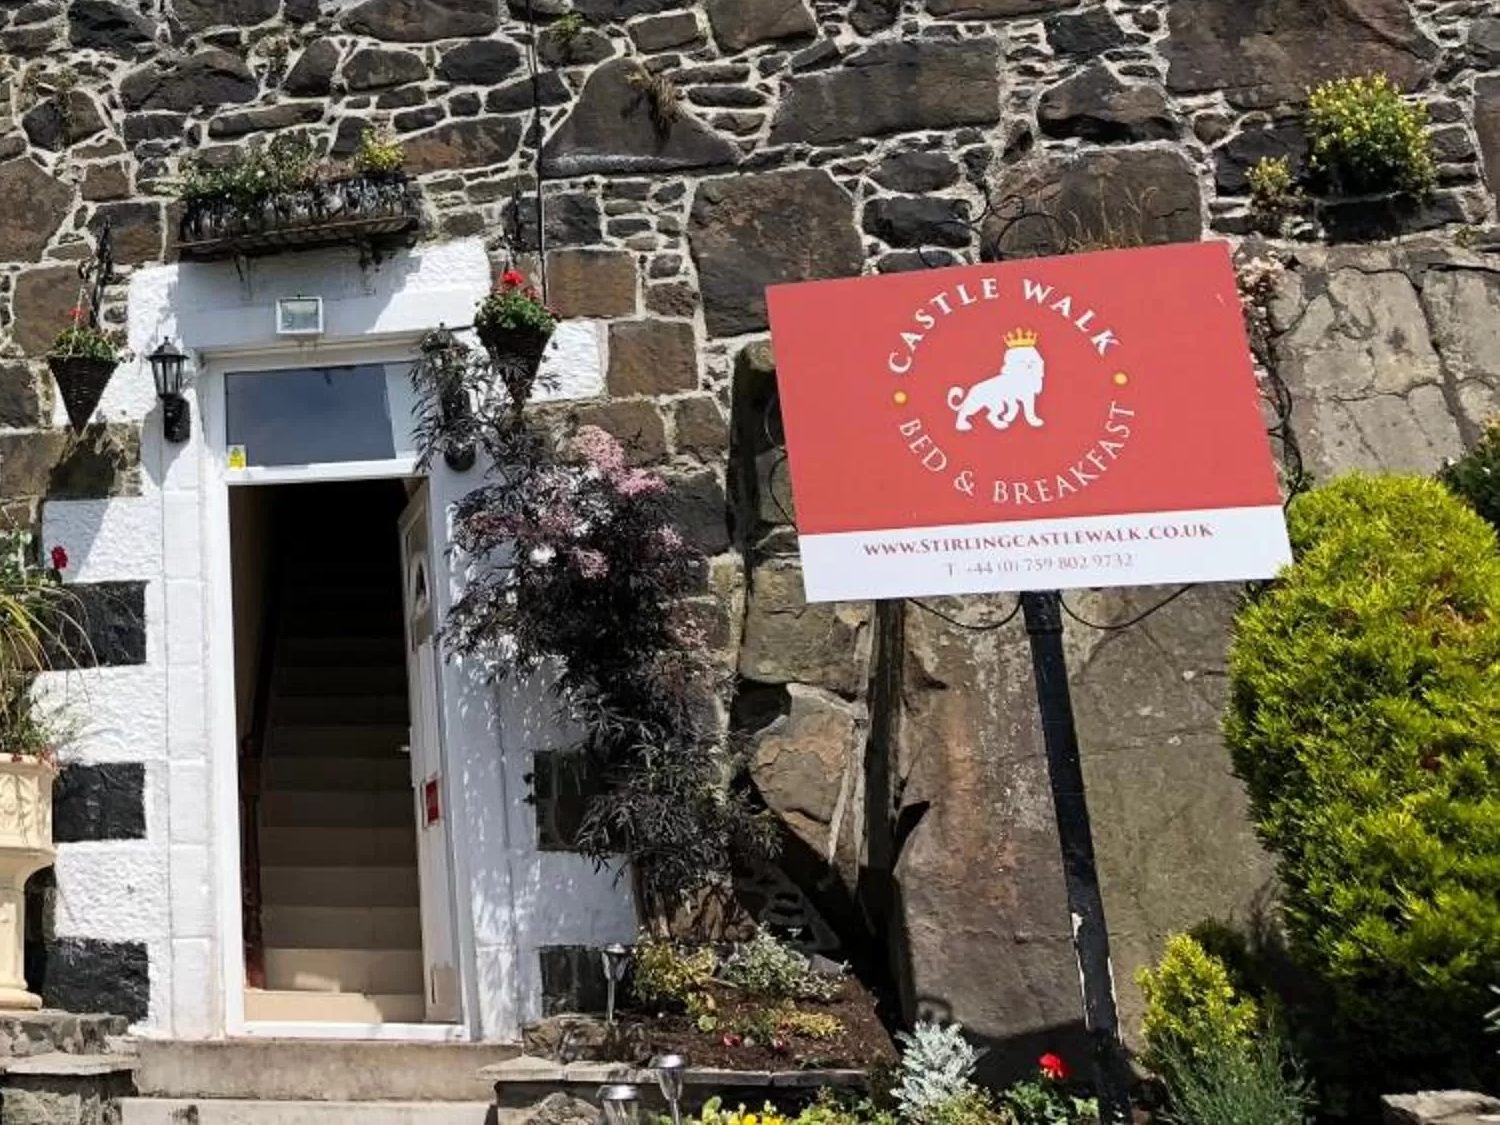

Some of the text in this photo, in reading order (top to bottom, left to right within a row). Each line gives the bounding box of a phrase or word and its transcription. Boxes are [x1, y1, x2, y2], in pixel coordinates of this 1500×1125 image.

[888, 278, 1121, 374] CASTLE WALK
[900, 401, 1135, 505] BED & BREAKFAST
[1025, 556, 1053, 572] 759
[1092, 552, 1134, 569] 9732
